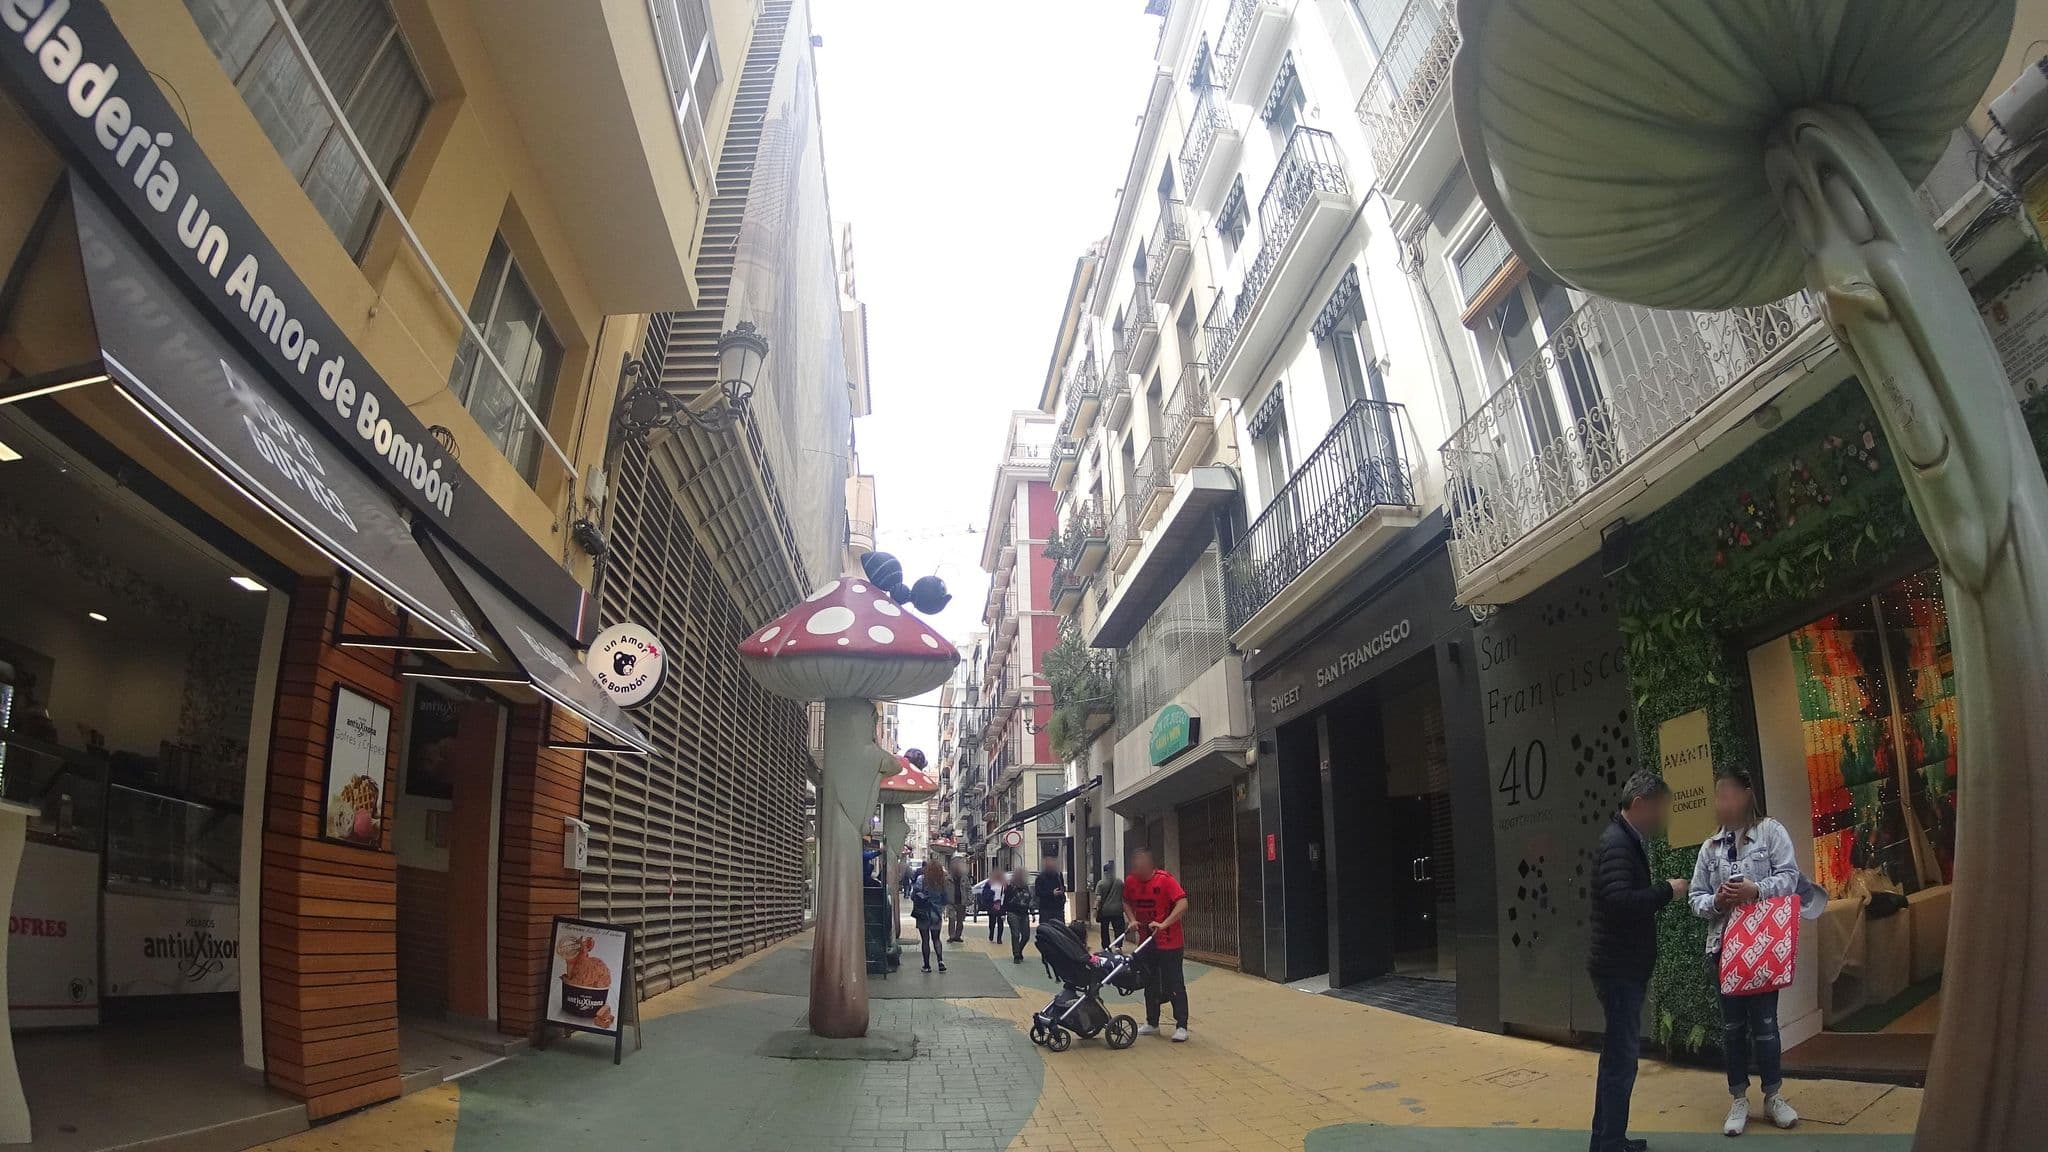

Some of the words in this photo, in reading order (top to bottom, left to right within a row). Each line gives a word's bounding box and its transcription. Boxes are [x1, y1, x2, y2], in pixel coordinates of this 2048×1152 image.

[177, 194, 229, 278] un
[225, 253, 320, 375] Amor
[318, 355, 357, 419] de
[356, 391, 454, 518] Bombón
[603, 639, 618, 653] un
[620, 635, 649, 653] Amor
[1316, 660, 1340, 688] SAN
[1339, 619, 1410, 675] FRANCISCO
[1481, 633, 1518, 671] San
[598, 672, 608, 686] de
[607, 674, 648, 694] Bombón
[1270, 685, 1301, 714] SWEET
[1664, 743, 1709, 769] AVANTI
[1498, 738, 1547, 806] 40
[1672, 797, 1707, 813] CONCEPT
[1673, 786, 1705, 801] ITALIAN
